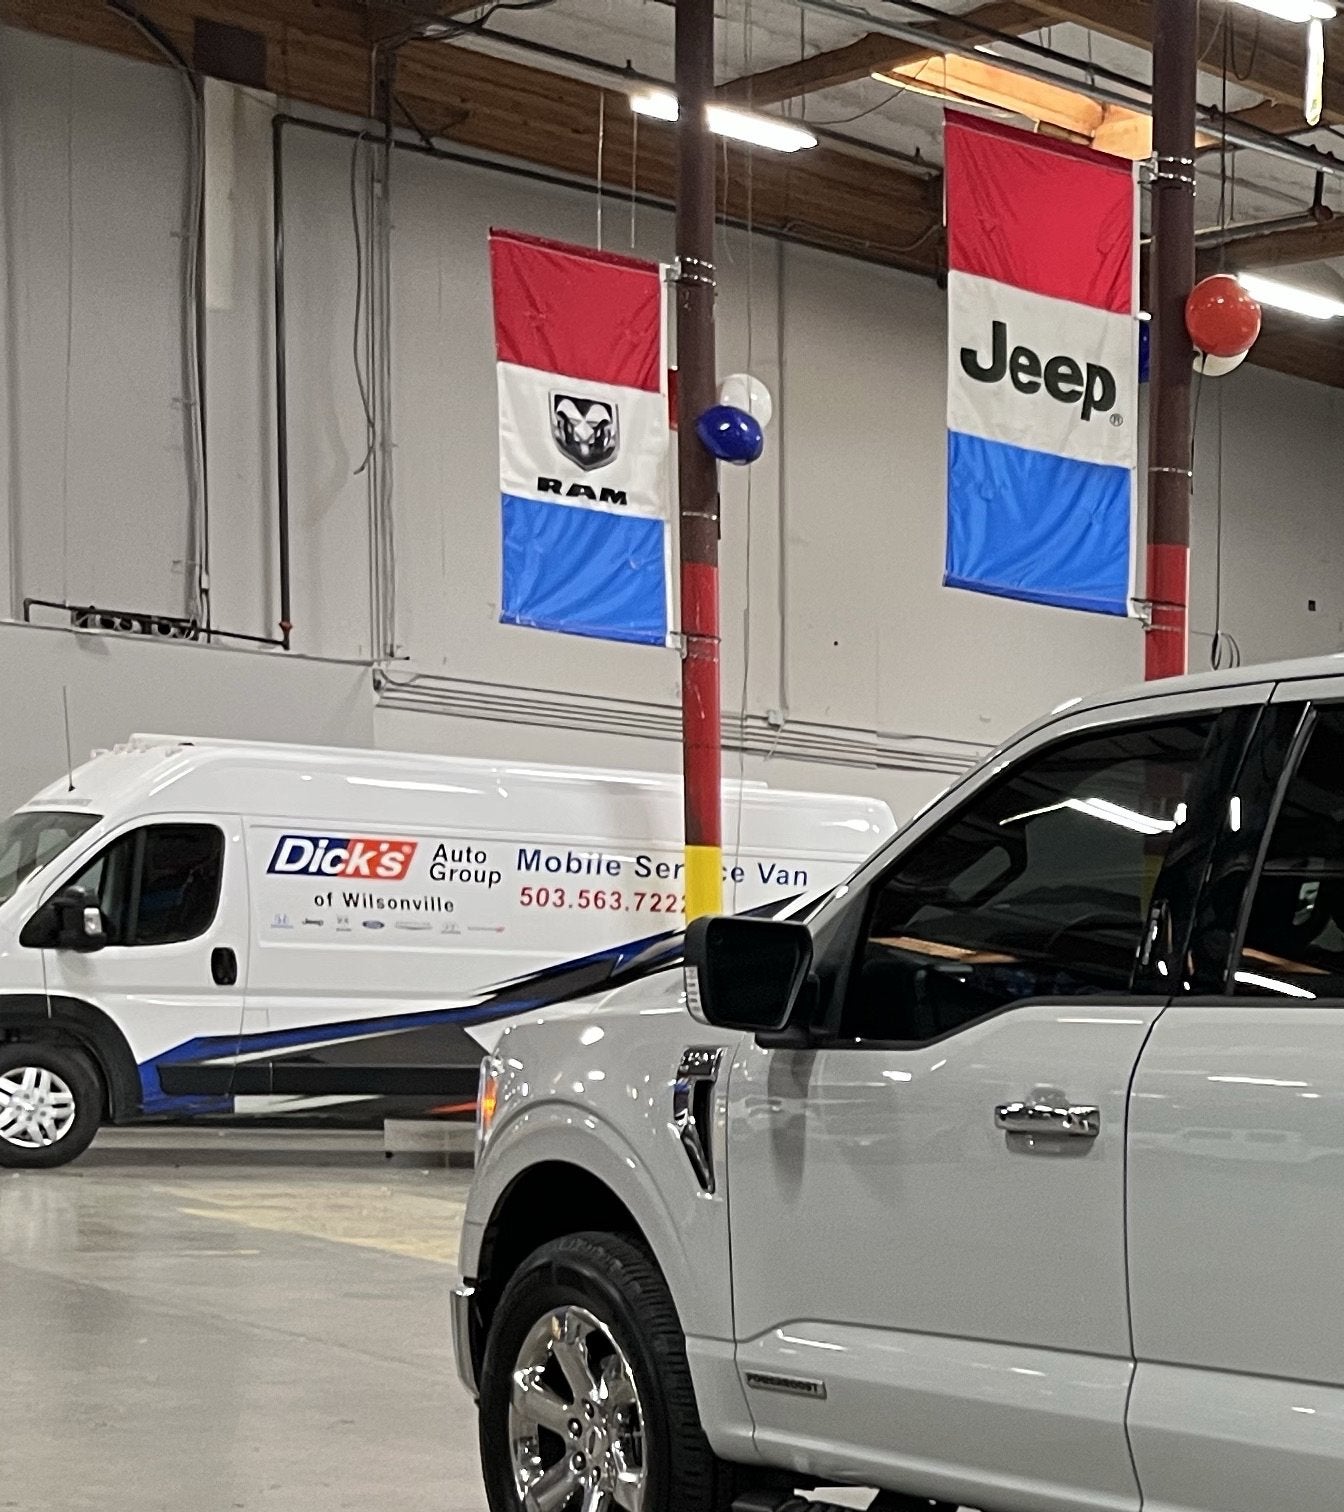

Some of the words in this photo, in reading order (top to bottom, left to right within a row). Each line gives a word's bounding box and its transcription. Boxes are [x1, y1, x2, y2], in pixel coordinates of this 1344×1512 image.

[537, 476, 628, 506] RAM
[432, 843, 487, 864] Auto
[429, 862, 502, 889] Group
[517, 848, 622, 876] Mobile
[634, 854, 745, 883] Sere
[757, 863, 808, 887] Van
[314, 892, 333, 907] of
[343, 892, 454, 912] Wilsonville
